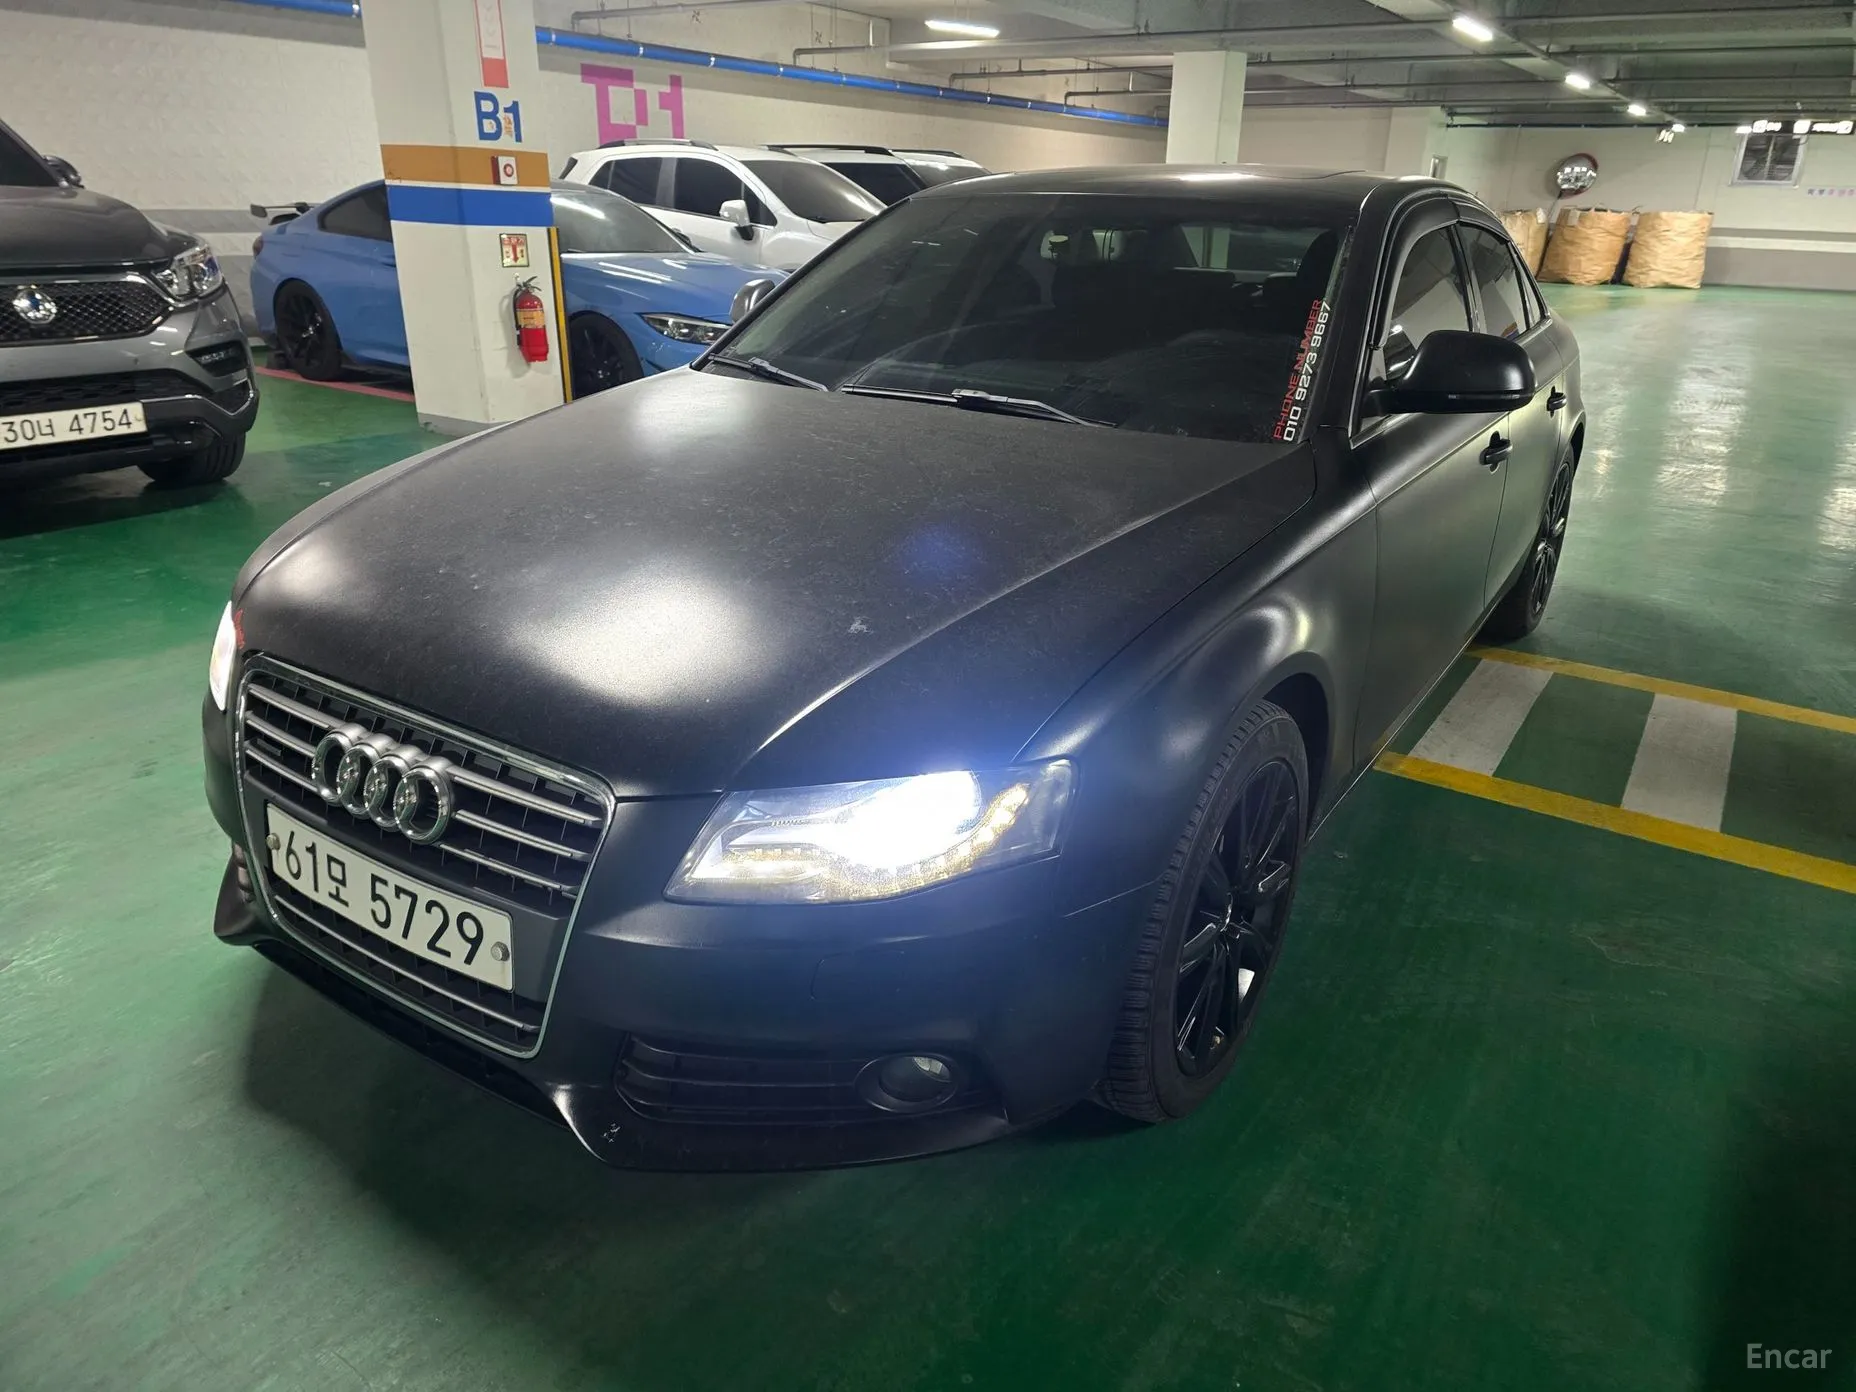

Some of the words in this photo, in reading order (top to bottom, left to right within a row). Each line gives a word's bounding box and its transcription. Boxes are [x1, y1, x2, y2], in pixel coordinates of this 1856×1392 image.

[474, 91, 522, 143] B1
[1, 418, 55, 443] 30너
[69, 408, 132, 435] 4754
[1273, 373, 1300, 440] PHONE
[1294, 299, 1322, 371] NUMBER
[1283, 406, 1302, 442] 010
[1295, 352, 1318, 401] 9273
[1311, 301, 1331, 348] 9667
[286, 831, 349, 908] 61모
[371, 873, 484, 966] 5729
